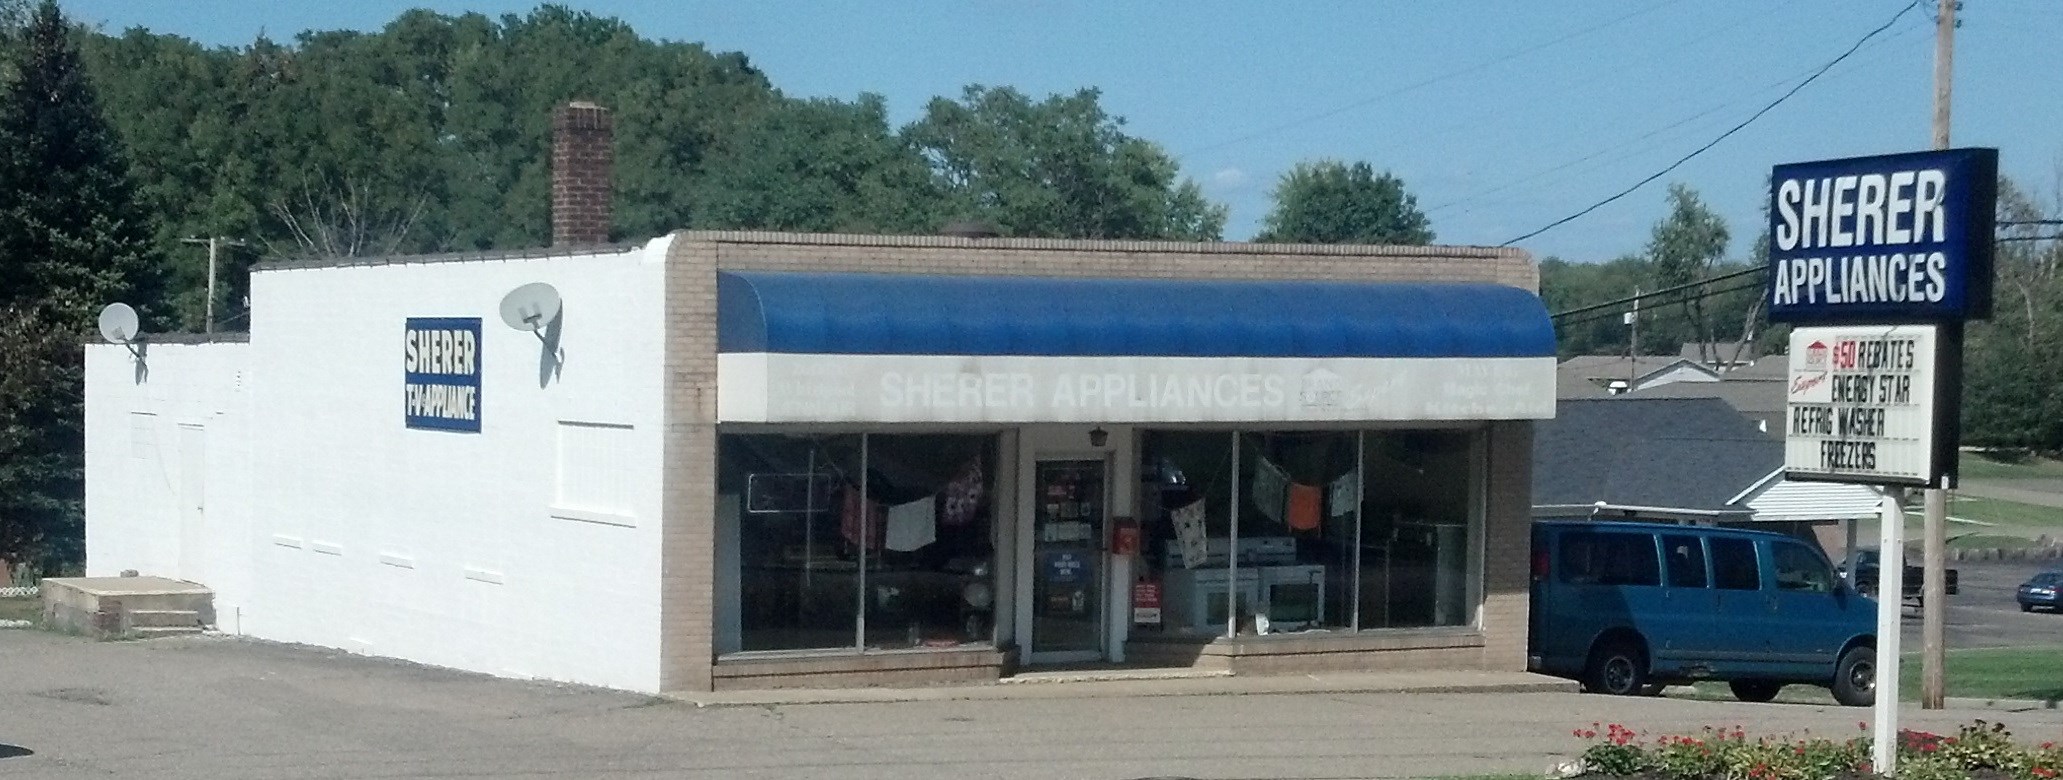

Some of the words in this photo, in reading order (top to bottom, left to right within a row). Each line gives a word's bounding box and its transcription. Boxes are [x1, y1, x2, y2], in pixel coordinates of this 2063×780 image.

[1776, 169, 1946, 251] SHERER
[1773, 252, 1946, 305] APPLIANCES
[406, 329, 476, 375] SHERER
[1832, 339, 1857, 369] $50
[1858, 339, 1915, 369] REBATES
[880, 371, 1035, 408] SHERER
[1051, 372, 1286, 408] APPLIANCES
[1831, 374, 1875, 403] ENERGY
[1878, 374, 1911, 403] STAR
[1793, 406, 1834, 434] REFRIG
[1838, 407, 1886, 437] WASHER
[1820, 440, 1877, 470] FREEZERS
